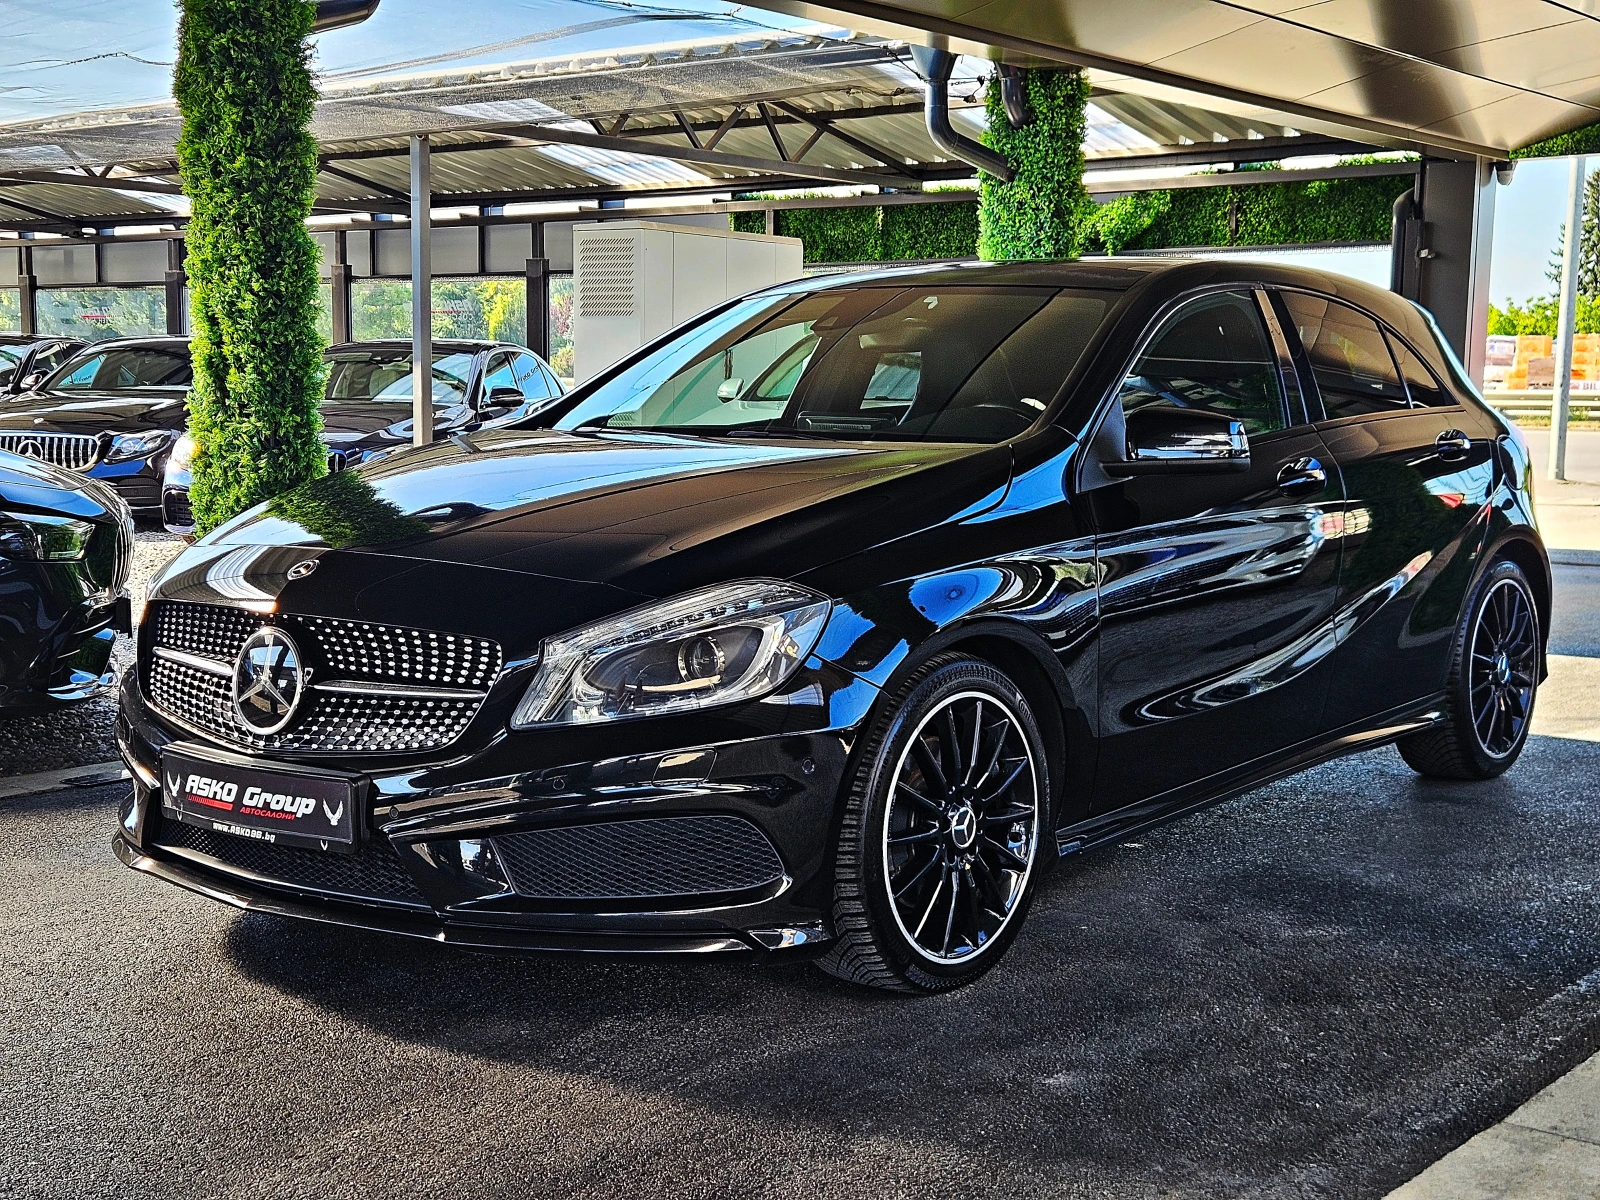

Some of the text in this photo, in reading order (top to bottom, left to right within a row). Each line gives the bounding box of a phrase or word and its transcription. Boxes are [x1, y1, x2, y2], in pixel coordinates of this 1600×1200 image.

[185, 774, 316, 818] ASKO Group
[240, 806, 295, 821] АВТОСАЛОНИ
